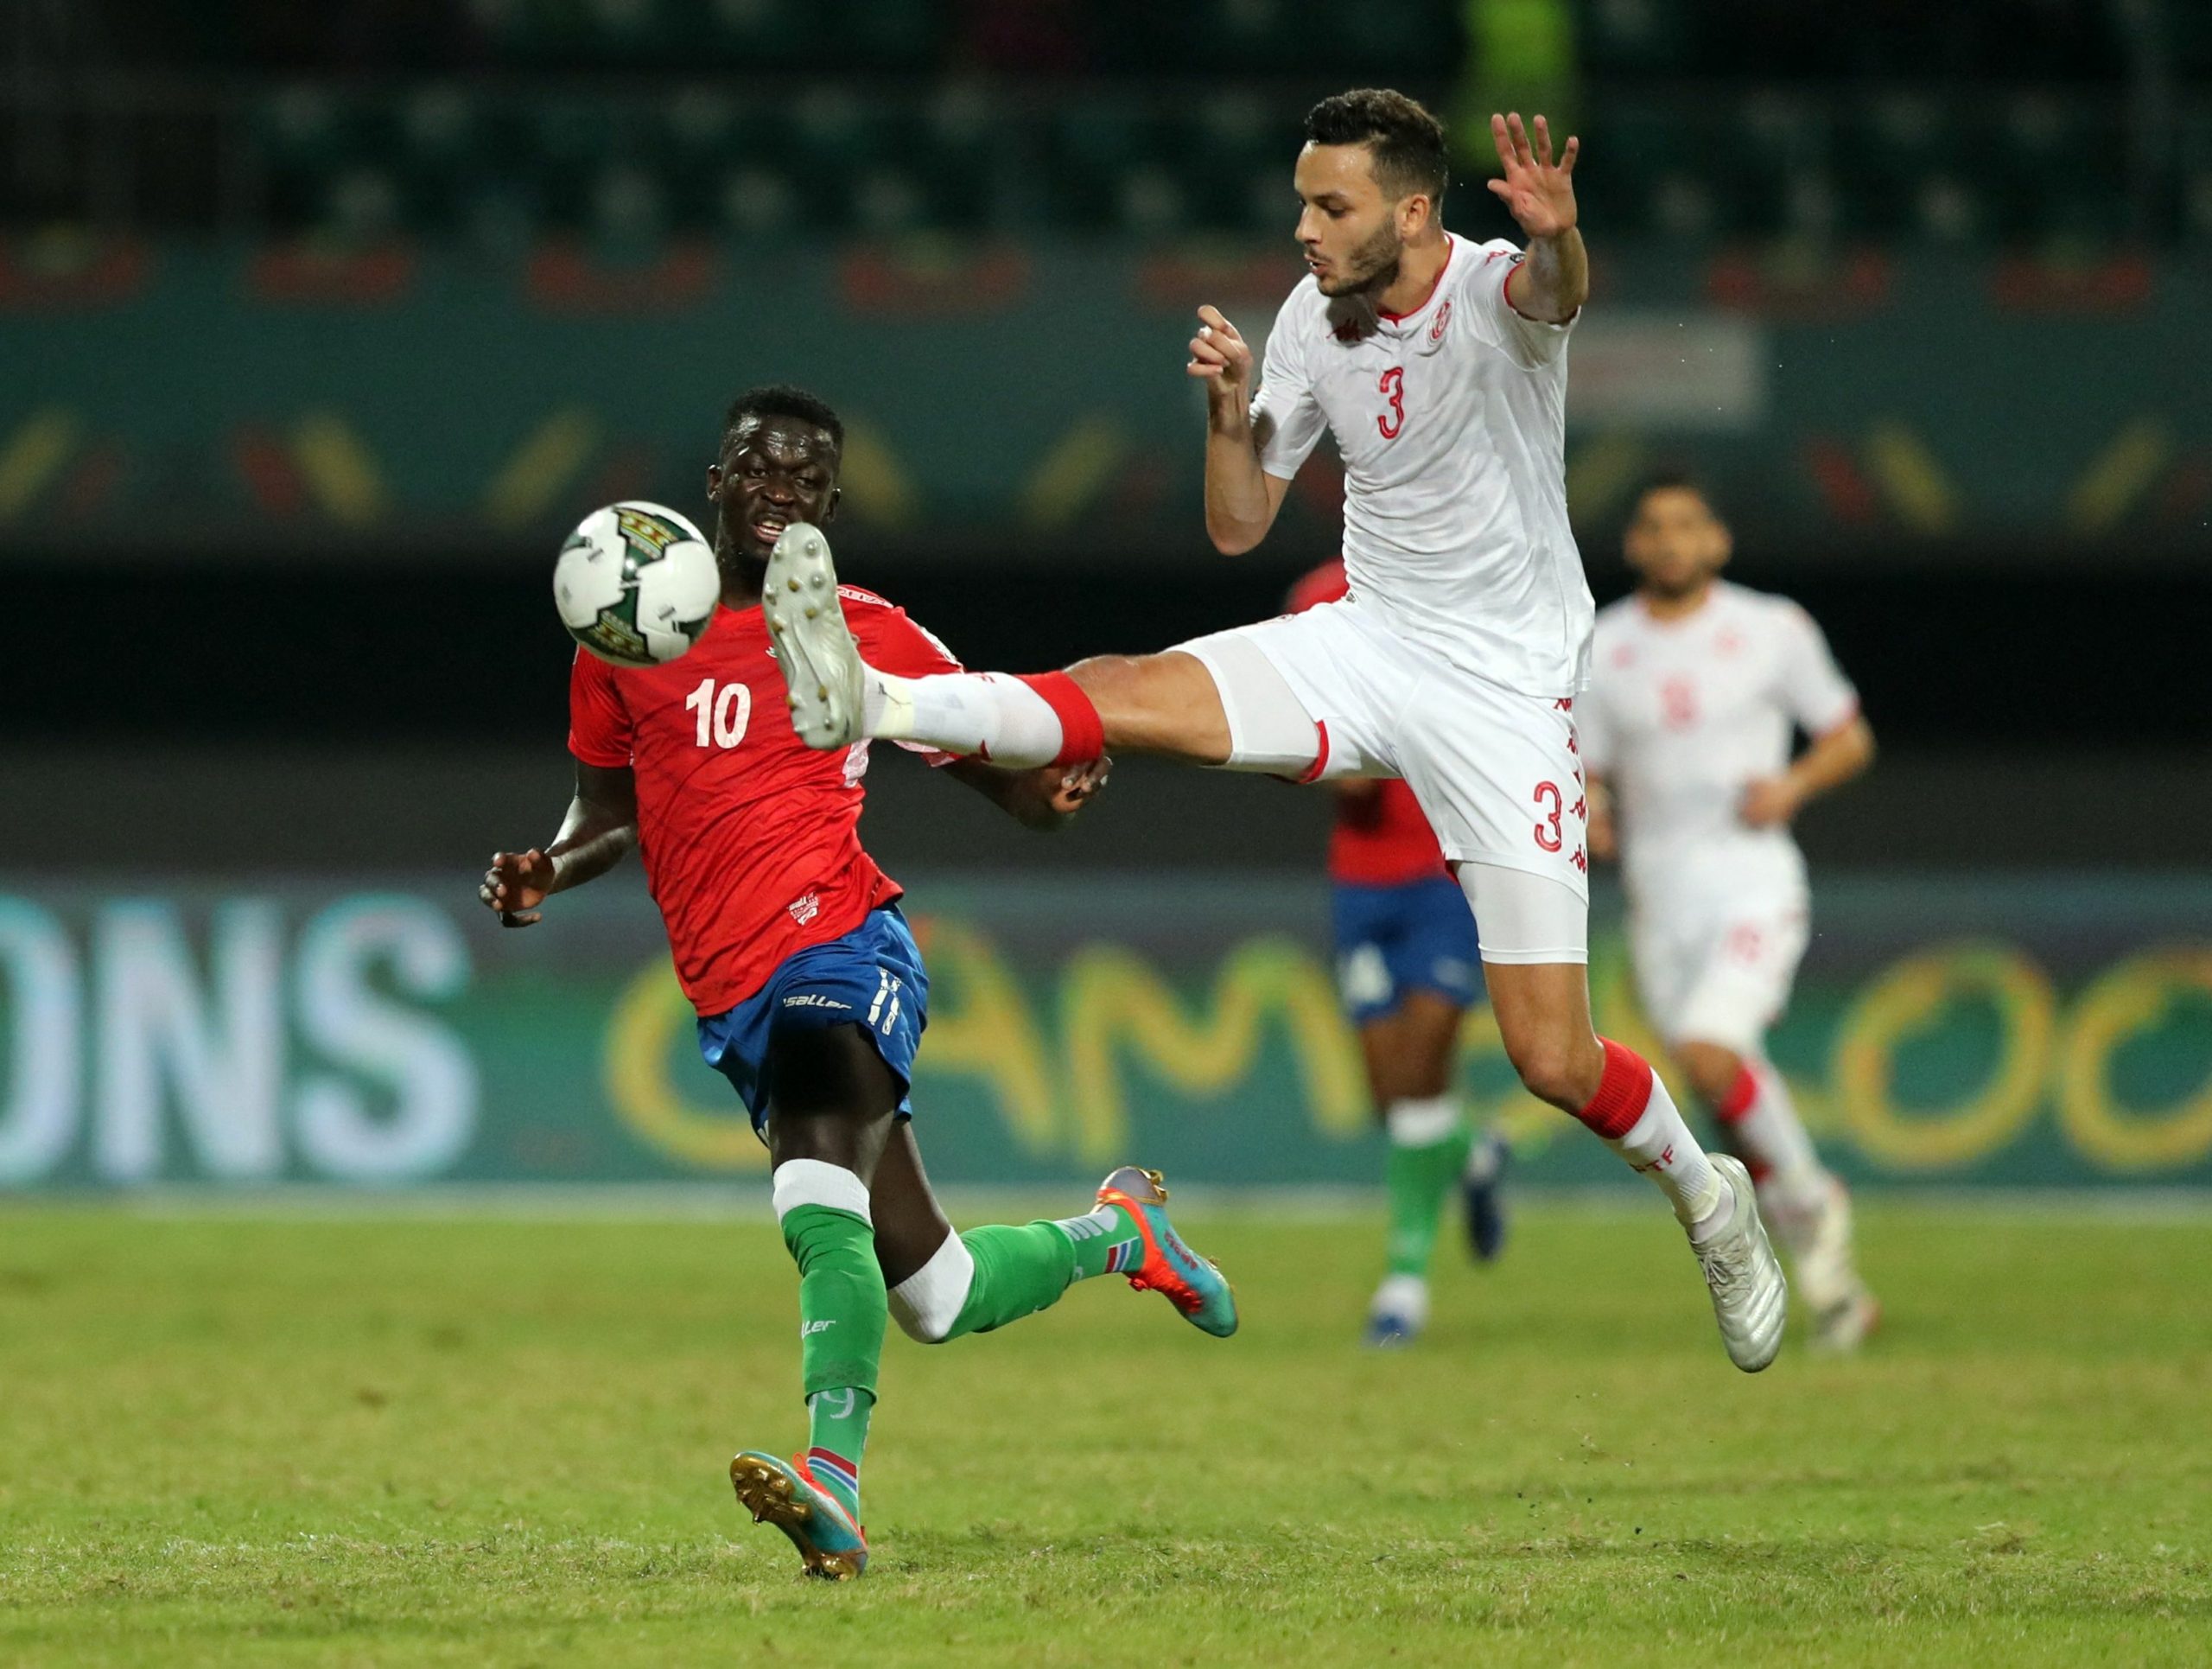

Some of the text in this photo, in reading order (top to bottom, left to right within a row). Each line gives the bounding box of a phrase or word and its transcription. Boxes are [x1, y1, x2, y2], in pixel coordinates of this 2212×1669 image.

[1377, 366, 1404, 440] 3
[685, 678, 751, 749] 10
[1533, 780, 1562, 853] 3
